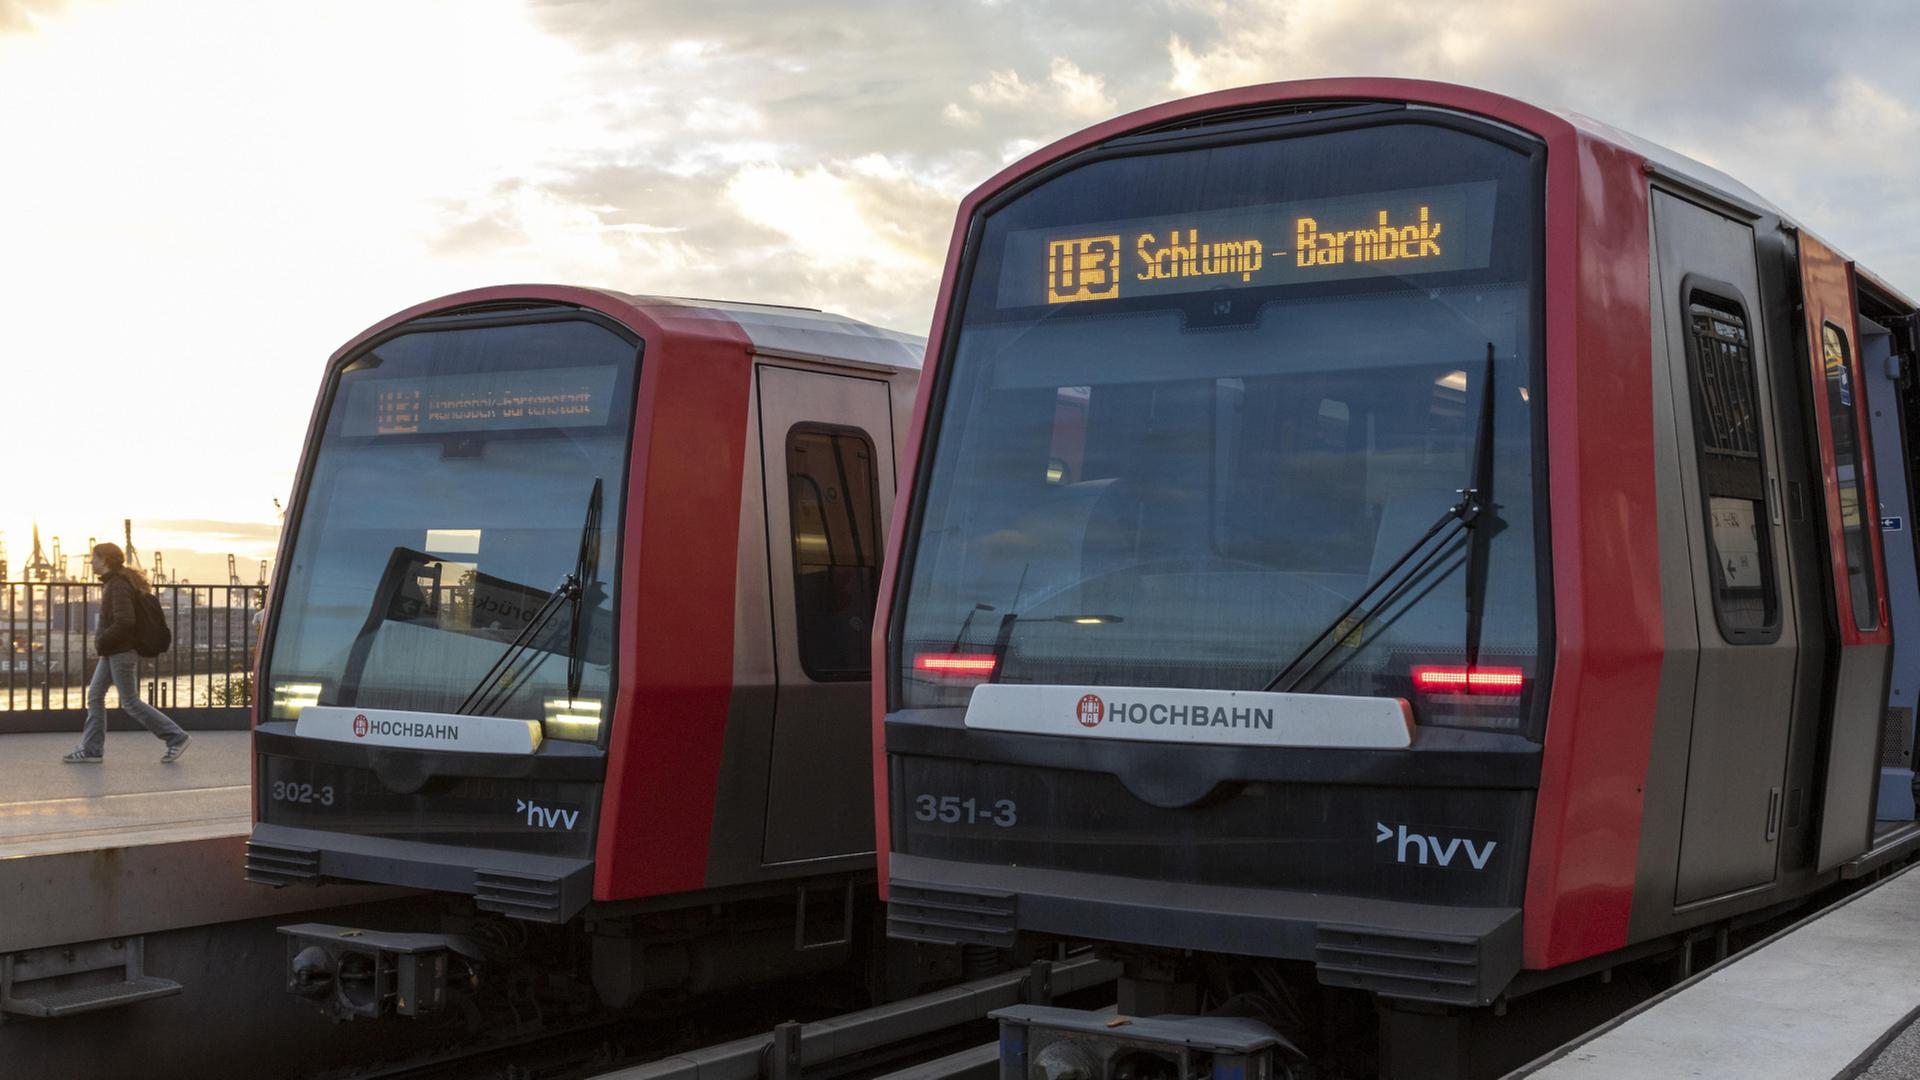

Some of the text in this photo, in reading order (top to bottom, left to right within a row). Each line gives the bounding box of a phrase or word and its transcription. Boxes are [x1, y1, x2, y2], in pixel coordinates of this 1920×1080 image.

[1053, 236, 1116, 300] U3
[1137, 228, 1263, 283] Schlump
[1297, 206, 1441, 267] Barmbek
[370, 720, 459, 740] HOCHBAHN
[1108, 702, 1274, 730] HOCHBAHN
[271, 780, 335, 806] 302-3
[914, 793, 1017, 828] 351-3
